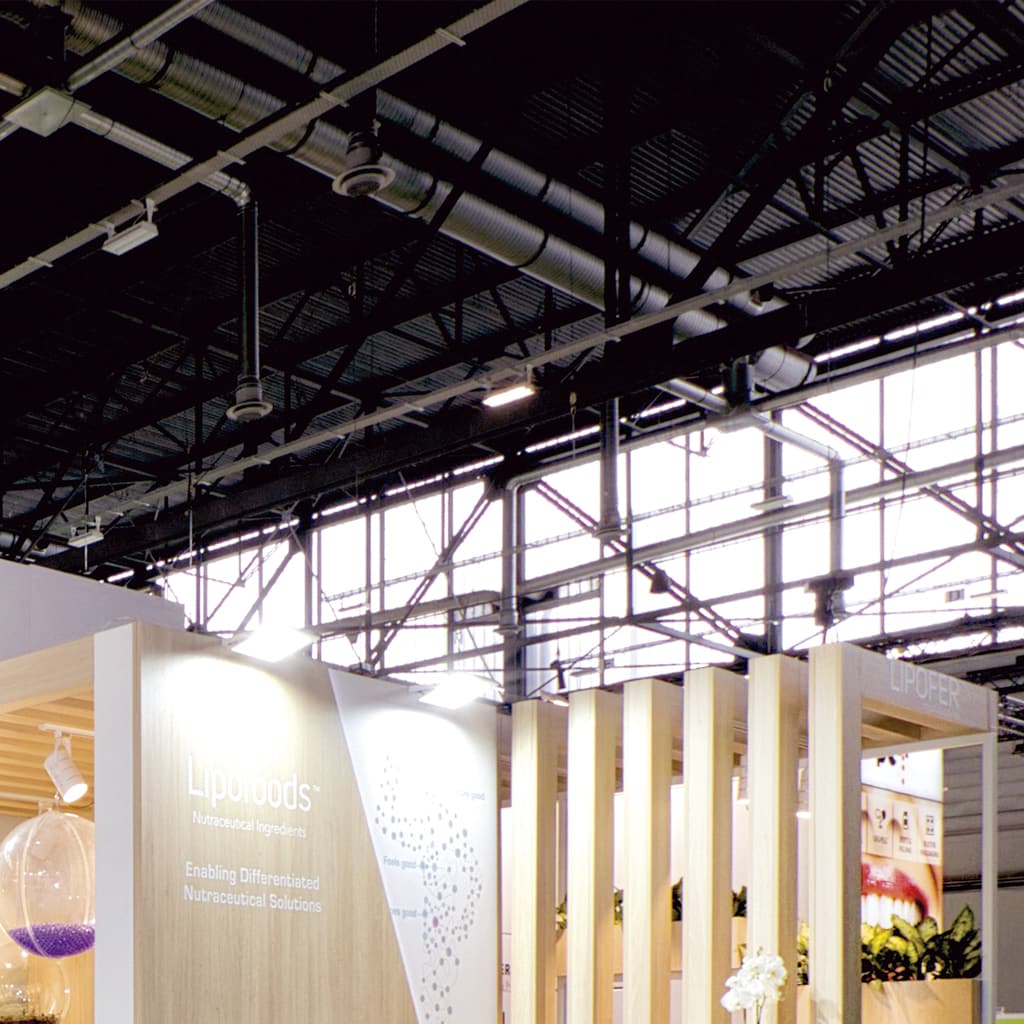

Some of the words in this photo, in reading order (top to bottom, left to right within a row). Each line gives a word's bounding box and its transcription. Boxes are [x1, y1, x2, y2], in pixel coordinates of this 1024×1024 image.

[890, 657, 960, 707] LIPOFER
[192, 811, 254, 832] Nutraceutical
[256, 818, 306, 839] Ingredients
[185, 861, 236, 885] Enabling
[240, 867, 319, 890] Differentiated
[184, 885, 266, 908] Nutraceutical
[270, 893, 322, 913] Solutions
